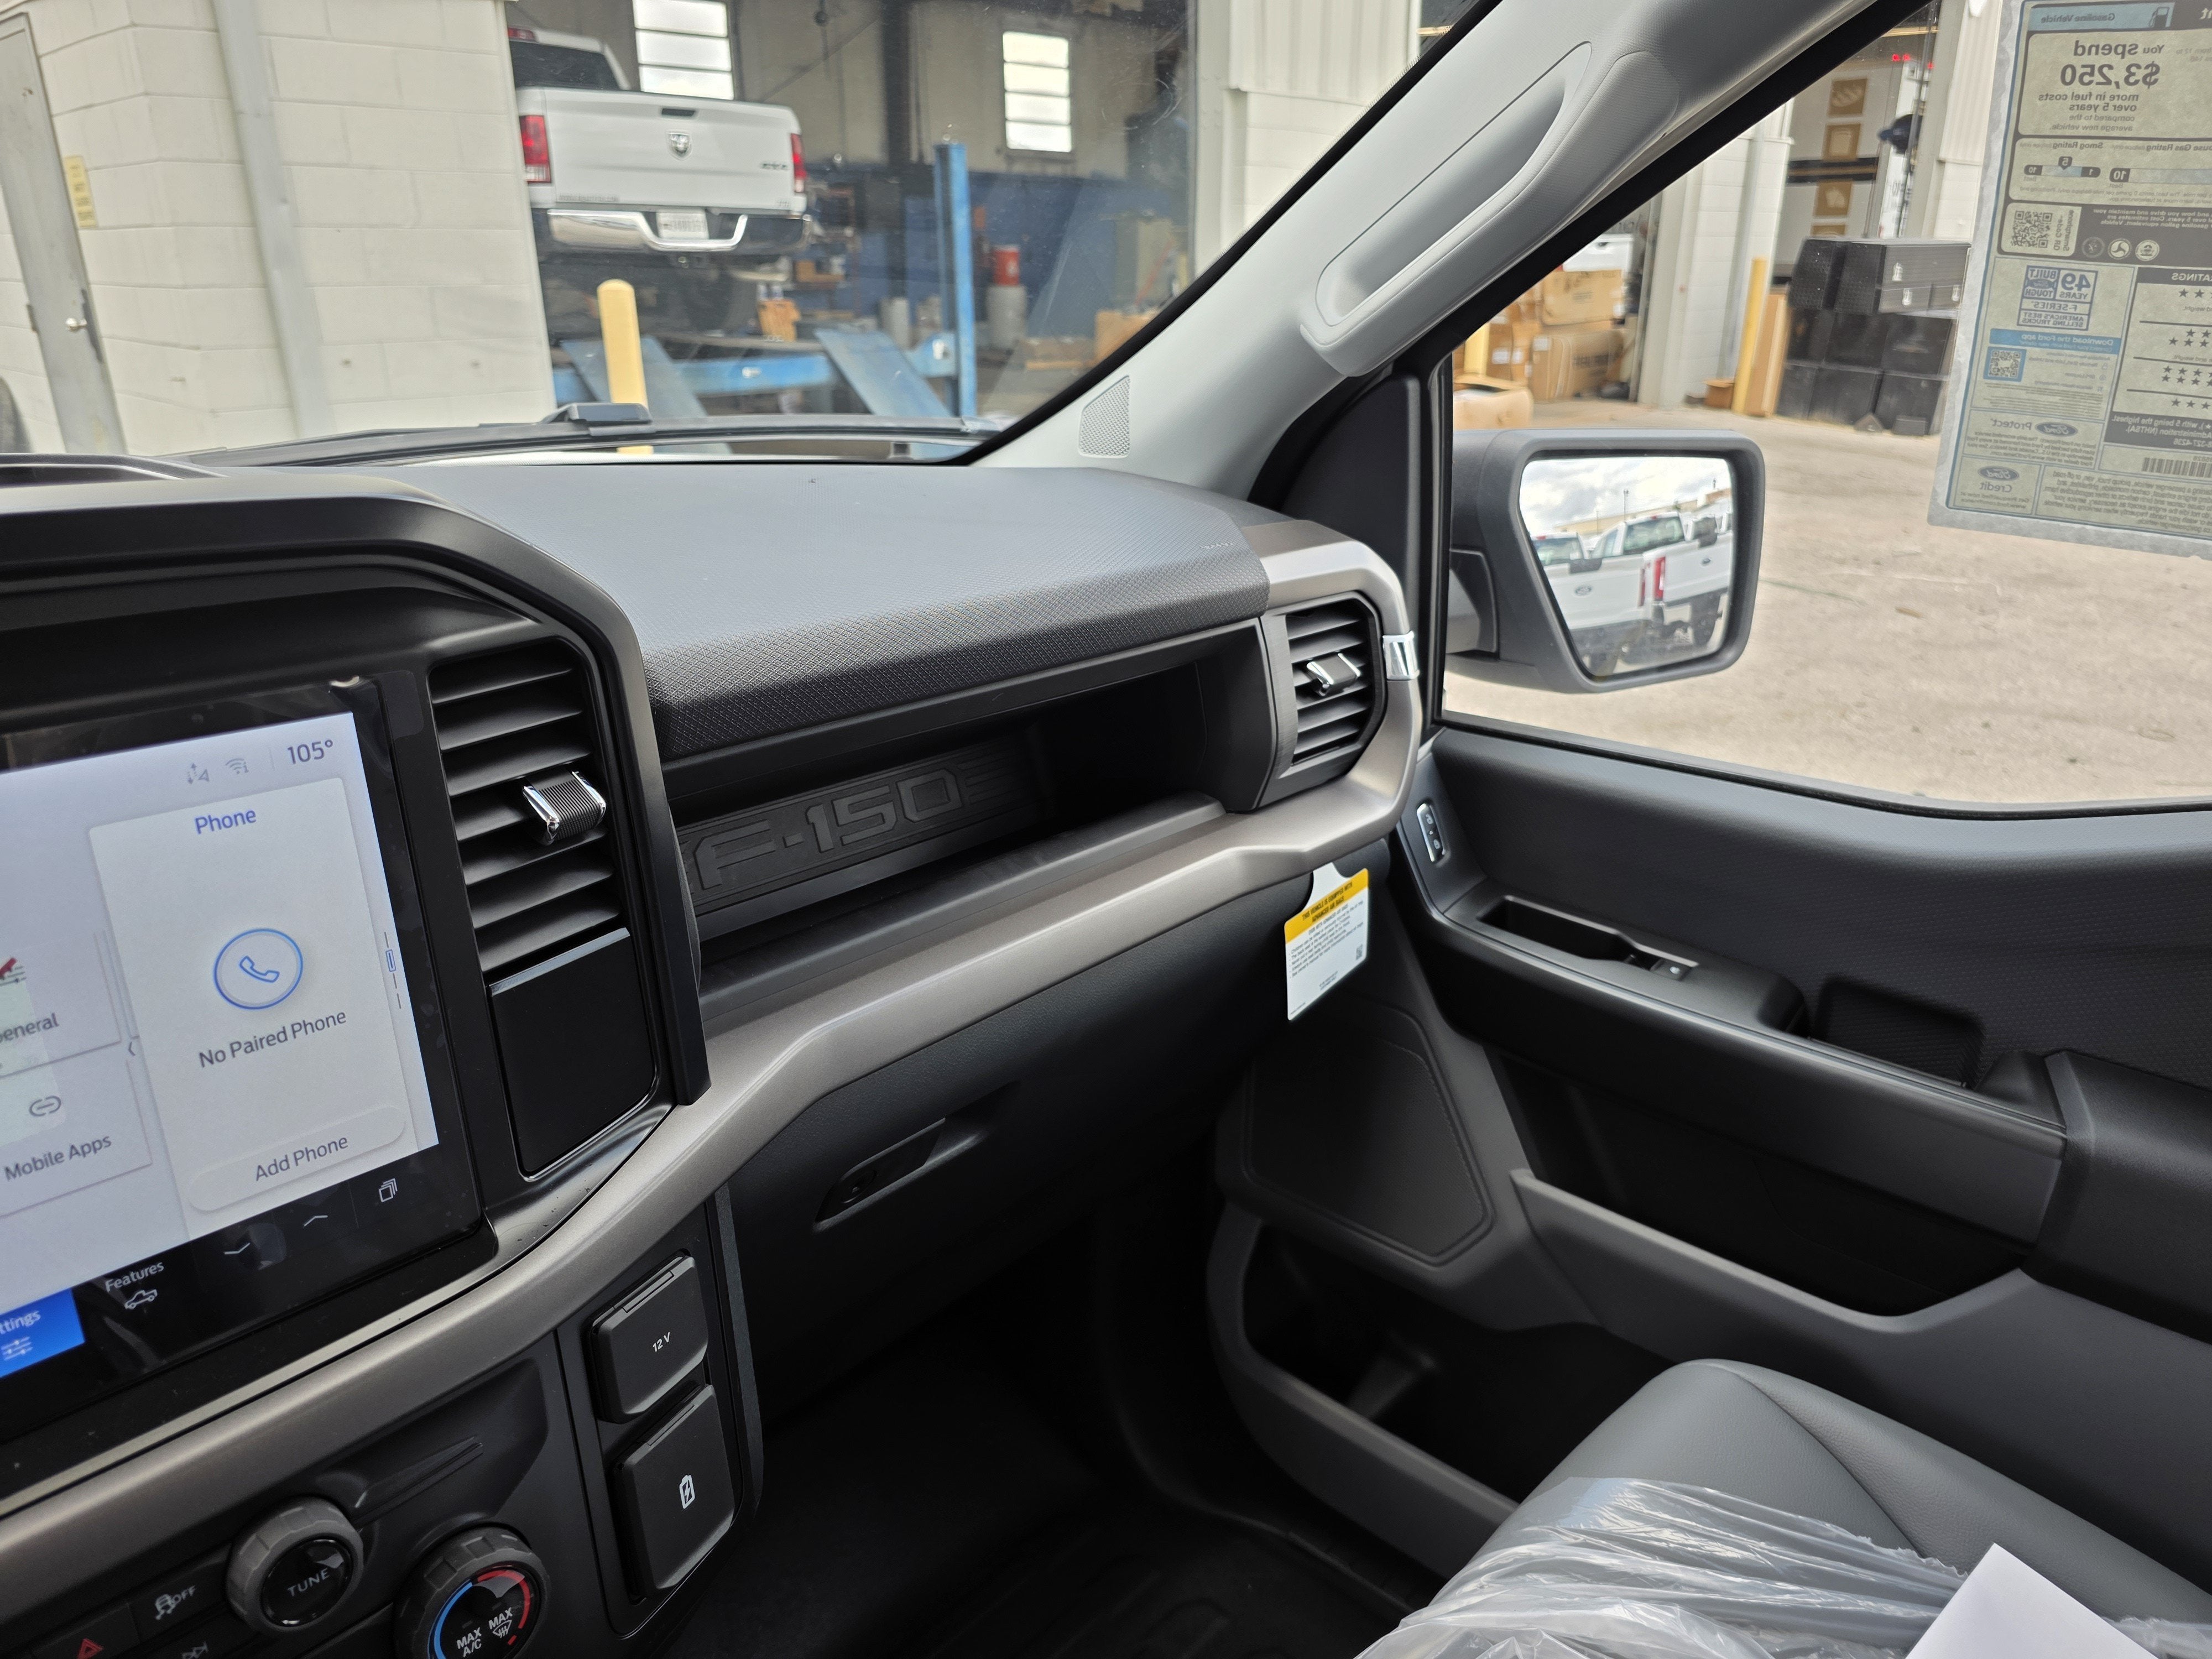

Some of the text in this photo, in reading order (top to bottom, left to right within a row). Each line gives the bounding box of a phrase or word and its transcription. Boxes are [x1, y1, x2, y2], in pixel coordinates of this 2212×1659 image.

[288, 739, 333, 764] 105°
[195, 810, 257, 834] Phone
[693, 769, 962, 891] F-150
[199, 1012, 347, 1068] No Paired Phone
[4, 1136, 112, 1181] Mobile Apps
[255, 1137, 348, 1181] Add Phone
[105, 1262, 164, 1293] Features
[653, 1332, 670, 1352] 12 V
[172, 1585, 196, 1604] OFF
[287, 1567, 330, 1597] TUNE
[488, 1607, 513, 1630] MAX
[456, 1627, 482, 1650] MAX
[463, 1639, 482, 1657] A/C
